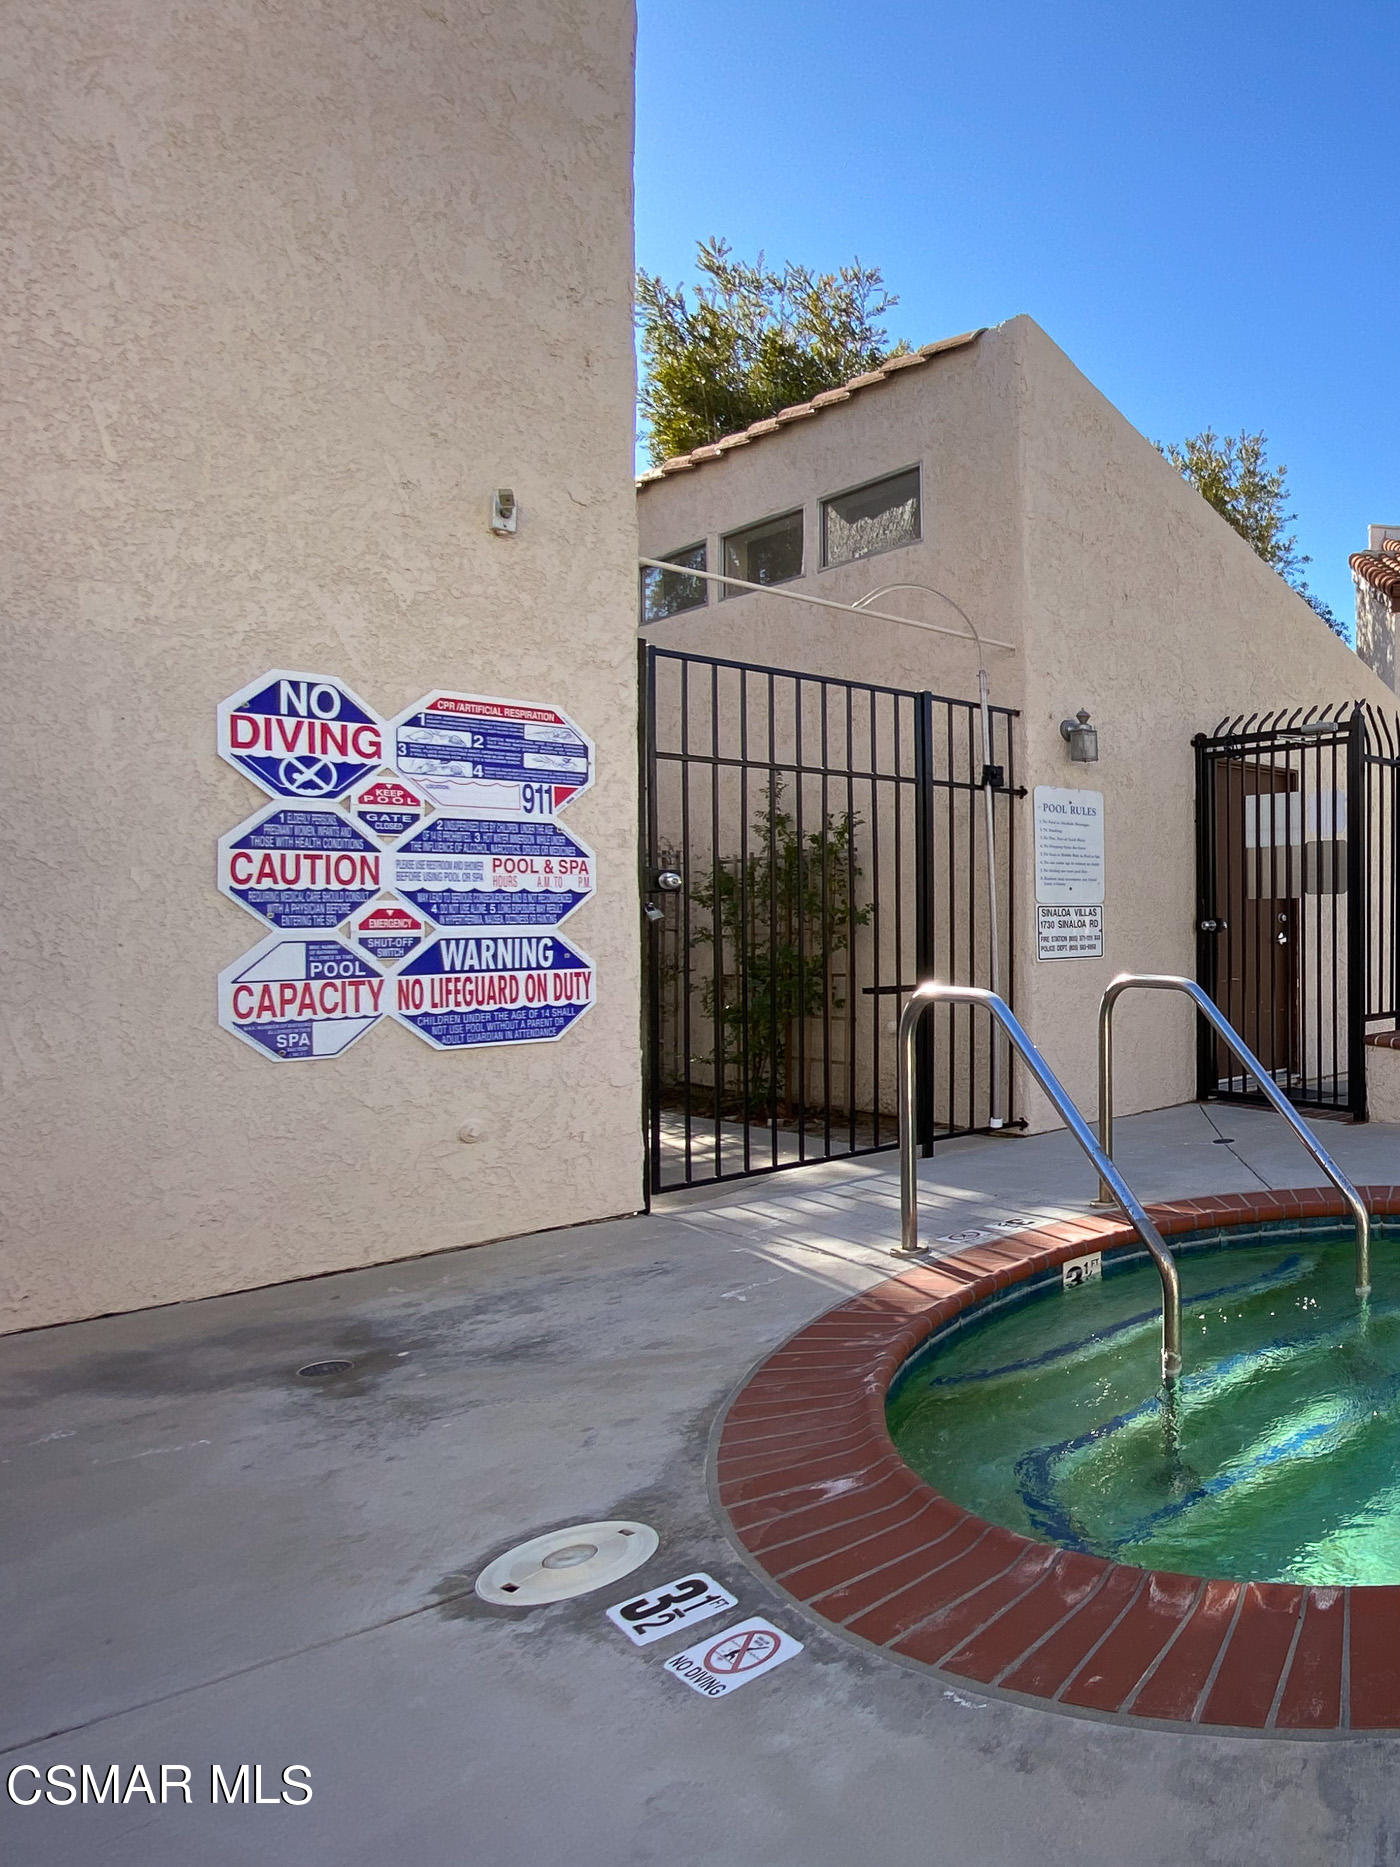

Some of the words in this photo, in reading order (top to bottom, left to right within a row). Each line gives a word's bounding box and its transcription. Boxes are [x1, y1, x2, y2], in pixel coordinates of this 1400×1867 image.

[280, 680, 341, 719] NO
[437, 700, 455, 711] CPR
[504, 708, 555, 722] RESPIRATION
[418, 714, 426, 725] 1
[230, 714, 382, 759] DIVING
[473, 735, 484, 748] 2
[398, 743, 407, 756] 3
[473, 765, 485, 777] 4
[363, 795, 417, 805] POOL
[522, 784, 553, 815] 911
[1043, 803, 1067, 814] POOL
[1070, 805, 1097, 816] RULES
[279, 814, 285, 823] 1
[366, 814, 412, 822] GATE
[375, 822, 403, 830] CLOSED
[436, 821, 443, 830] 2
[250, 836, 275, 848] THOSE
[276, 837, 294, 848] WITH
[295, 837, 322, 849] HEALTH
[323, 838, 364, 850] CONDITIONS
[230, 851, 380, 886] CAUTION
[492, 857, 539, 874] POOL
[543, 859, 554, 874] &
[558, 859, 589, 875] SPA
[396, 871, 421, 881] BEFORE
[423, 871, 442, 881] USING
[443, 872, 461, 882] POOL
[462, 872, 471, 882] OR
[471, 872, 484, 882] SPA
[492, 875, 518, 888] HOURS
[553, 876, 563, 888] TO
[267, 903, 283, 914] WITH
[290, 903, 326, 914] PHYSICIAN
[326, 903, 352, 914] BEFORE
[1041, 908, 1071, 917] SINALOA
[1074, 908, 1097, 917] VILLAS
[281, 915, 312, 926] ENTERING
[312, 915, 325, 926] THE
[369, 919, 412, 928] EMERGENCY
[1041, 920, 1055, 929] 1730
[1058, 919, 1086, 928] SINALOA
[1089, 919, 1098, 928] RD
[368, 938, 414, 947] SHUT-OFF
[377, 948, 404, 957] SWITCH
[440, 937, 554, 971] WARNING
[310, 961, 366, 978] POOL
[397, 978, 424, 1011] NO
[431, 975, 519, 1008] LIFEGUARD
[525, 973, 548, 1003] ON
[553, 971, 592, 1002] DUTY
[233, 979, 384, 1020] CAPACITY
[417, 1015, 461, 1026] CHILDREN
[463, 1013, 491, 1023] UNDER
[494, 1012, 509, 1021] THE
[511, 1010, 527, 1020] AGE
[529, 1010, 539, 1019] OF
[541, 1009, 550, 1018] 14
[552, 1008, 576, 1017] SHALL
[432, 1025, 448, 1035] NOT
[449, 1025, 464, 1034] USE
[465, 1023, 485, 1033] POOL
[487, 1021, 519, 1031] WITHOUT
[520, 1020, 526, 1029] A
[527, 1019, 553, 1028] PARENT
[554, 1018, 564, 1026] OR
[277, 1034, 311, 1048] SPA
[441, 1035, 465, 1045] ADULT
[466, 1033, 504, 1043] GUARDIAN
[505, 1032, 513, 1040] IN
[514, 1028, 558, 1039] ATTENDANCE
[620, 1579, 709, 1621] 3
[709, 1598, 730, 1609] FT
[668, 1655, 694, 1671] NO
[685, 1667, 727, 1696] DIVING
